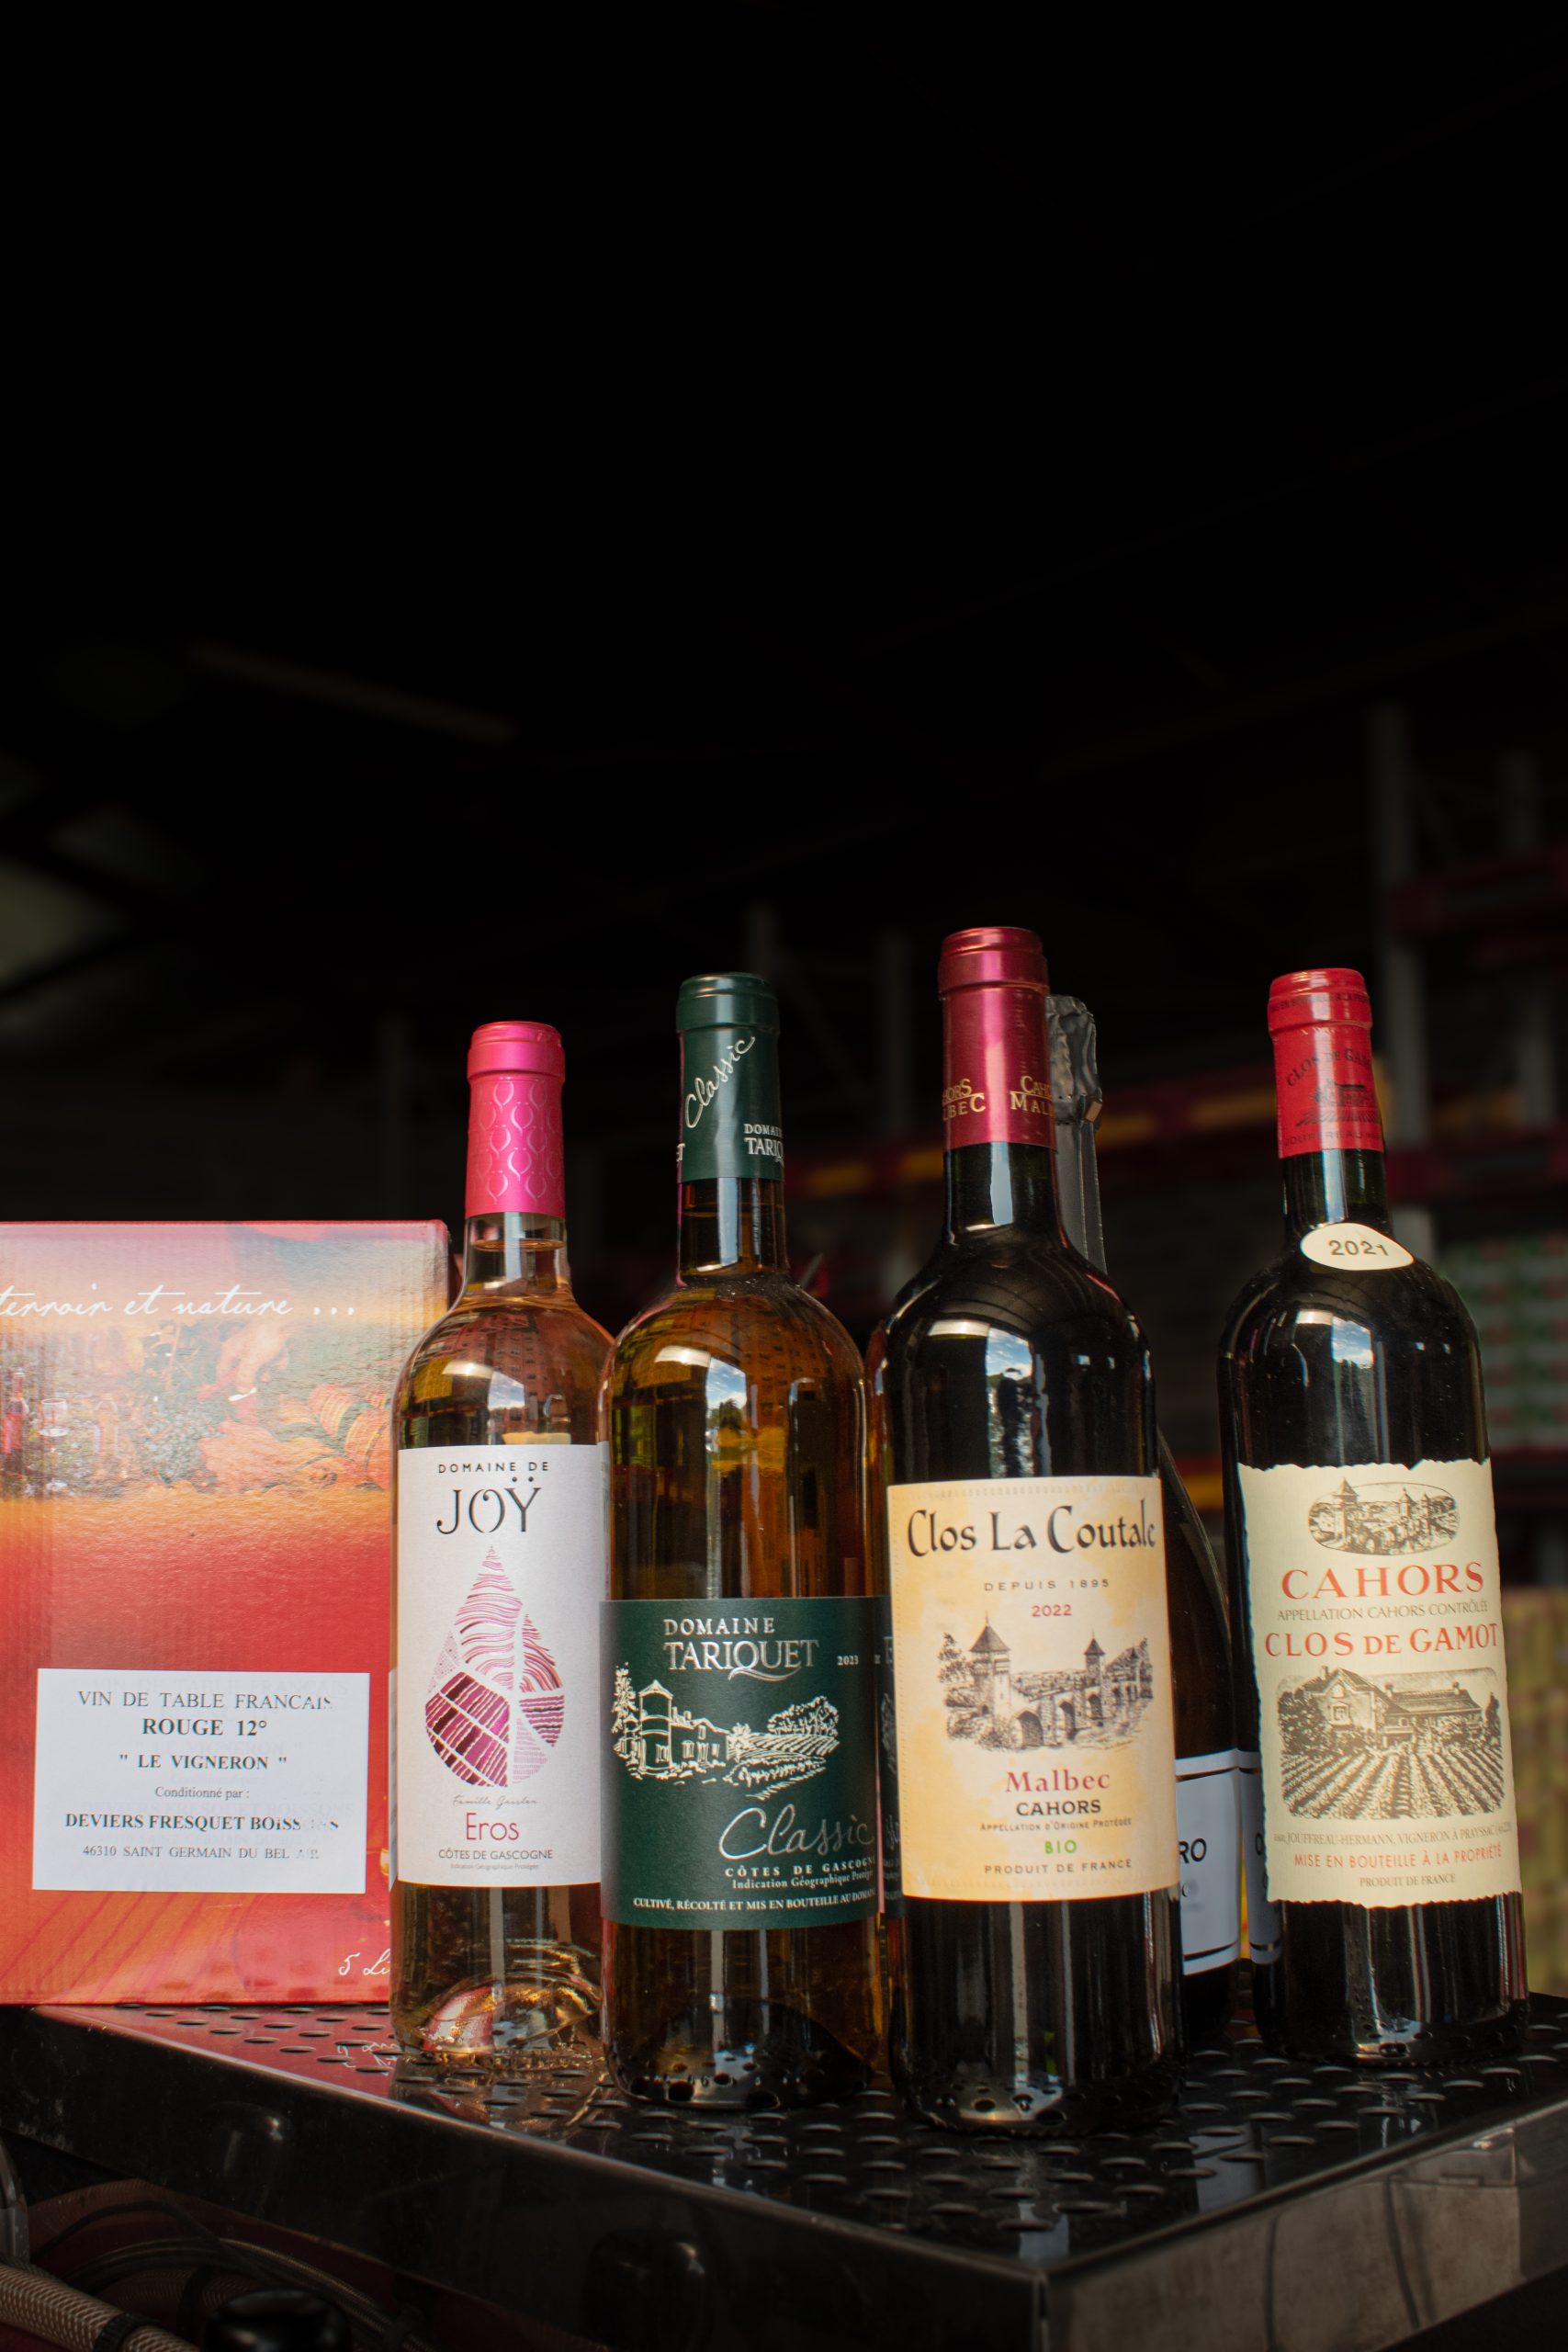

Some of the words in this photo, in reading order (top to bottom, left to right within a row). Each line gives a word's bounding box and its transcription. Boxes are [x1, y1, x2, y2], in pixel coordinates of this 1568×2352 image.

[685, 1036, 756, 1128] Classic
[1328, 1239, 1390, 1257] 2021
[124, 1285, 185, 1316] et
[173, 1284, 293, 1316] nature
[438, 1462, 516, 1474] DOMAINE
[528, 1461, 548, 1471] DE
[908, 1510, 977, 1557] Clos
[989, 1511, 1037, 1551] La
[1047, 1498, 1156, 1554] Coutale
[984, 1580, 1056, 1591] DEPUIS
[1070, 1579, 1110, 1589] 1895
[1280, 1561, 1484, 1600] CAHORS
[1032, 1604, 1073, 1617] 2022
[1277, 1608, 1364, 1623] APPELLATION
[1367, 1605, 1426, 1619] CAHORS
[663, 1618, 776, 1635] DOMAINE
[1265, 1632, 1354, 1657] CLOS
[1363, 1634, 1401, 1655] DE
[1409, 1623, 1497, 1653] GAMOT
[662, 1639, 820, 1681] TARIQUET
[77, 1690, 112, 1707] VIN
[123, 1691, 149, 1707] DE
[160, 1692, 224, 1709] TABLE
[142, 1718, 224, 1736] ROUGE
[237, 1720, 267, 1736] 12°
[138, 1754, 162, 1769] LE
[171, 1755, 269, 1770] VIGNERON
[1005, 1770, 1111, 1792] Malbec
[154, 1786, 222, 1798] Conditionné
[1016, 1799, 1102, 1816] CAHORS
[65, 1814, 144, 1829] DEVIERS
[149, 1815, 245, 1833] FRESQUET
[466, 1812, 520, 1841] Eros
[718, 1804, 875, 1860] Classic
[83, 1846, 117, 1857] 46310
[123, 1846, 162, 1858] SAINT
[169, 1847, 231, 1859] GERMAIN
[238, 1848, 258, 1859] DU
[265, 1848, 290, 1860] BEL
[438, 1848, 469, 1860] CÔTES
[473, 1849, 488, 1860] DE
[490, 1849, 553, 1860] GASCOGNE
[1045, 1839, 1077, 1854] BIO
[1293, 1854, 1321, 1867] MISE
[1325, 1855, 1344, 1867] EN
[1349, 1853, 1416, 1868] BOUTEILLE
[1423, 1849, 1432, 1866] À
[1437, 1853, 1450, 1865] LA
[1454, 1843, 1502, 1862] PROPRIÉTÉ
[725, 1864, 781, 1877] CÔTES
[793, 1864, 813, 1875] DE
[985, 1864, 1049, 1874] PRODUIT
[1056, 1864, 1074, 1872] DE
[1082, 1860, 1132, 1871] FRANCE
[732, 1879, 788, 1889] Indication
[791, 1873, 851, 1889] Géographique
[1359, 1876, 1404, 1888] PRODUIT
[1406, 1876, 1419, 1886] DE
[1422, 1873, 1456, 1885] FRANCE
[676, 1898, 727, 1911] RÉCOLTÉ
[729, 1901, 744, 1911] ET
[746, 1900, 766, 1910] MIS
[769, 1899, 784, 1910] EN
[786, 1894, 839, 1908] BOUTEILLE
[840, 1892, 852, 1904] AU
